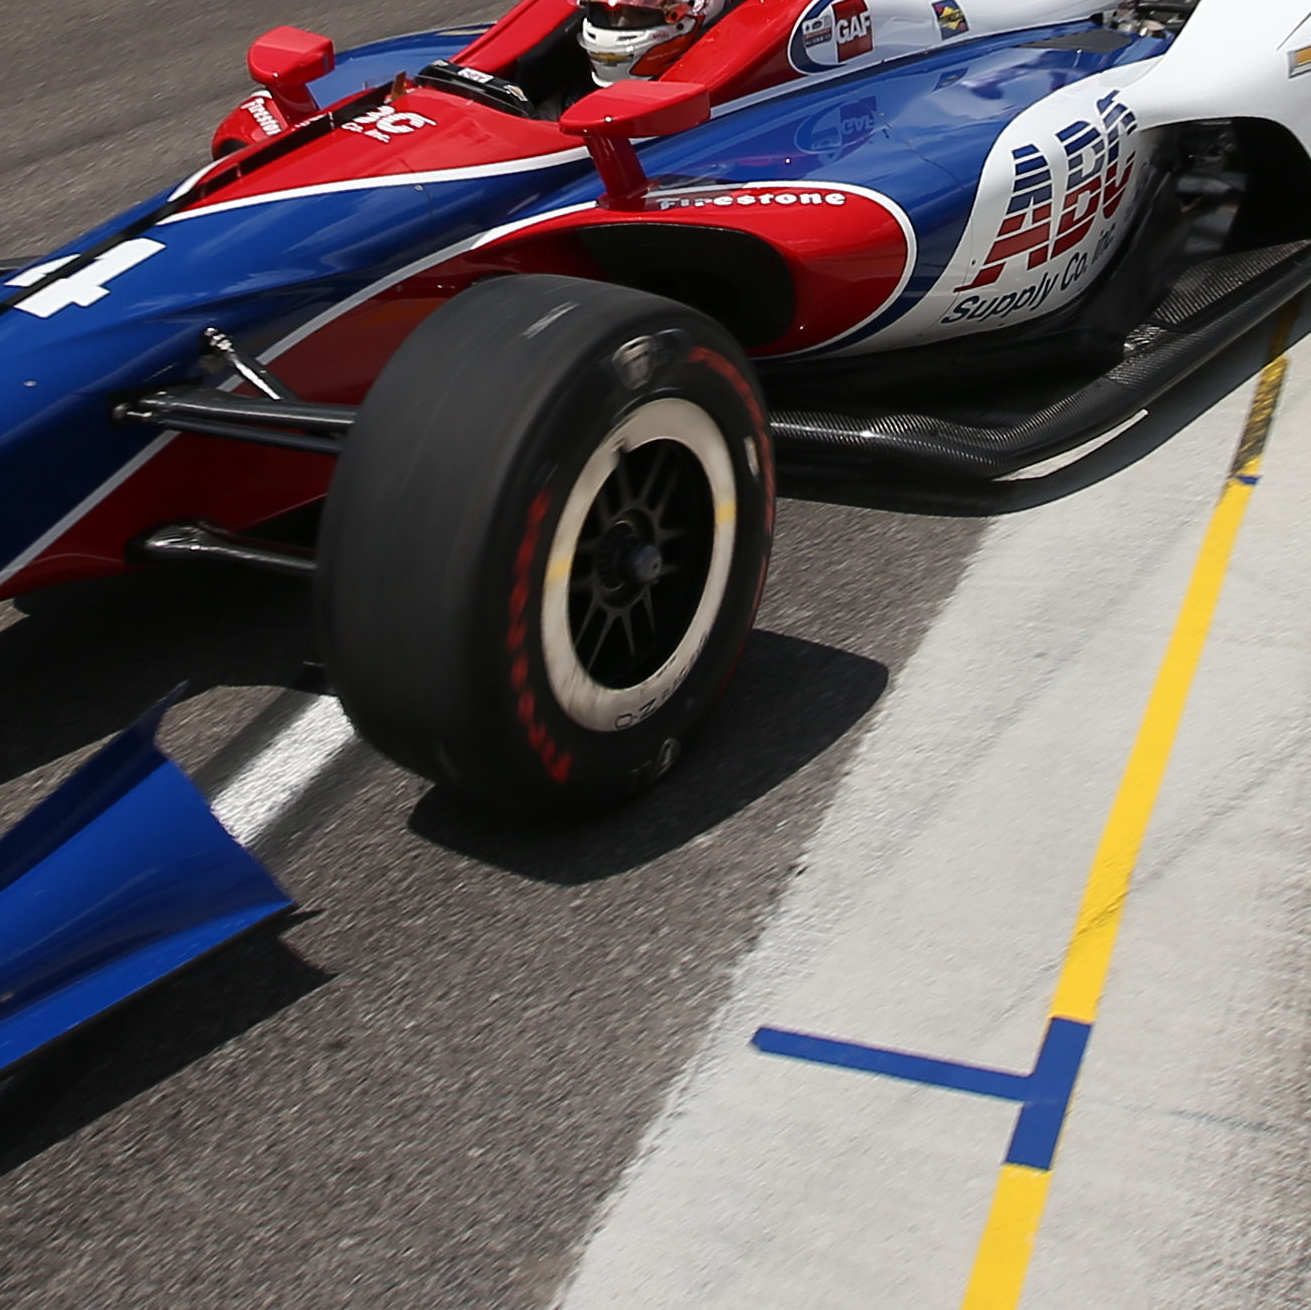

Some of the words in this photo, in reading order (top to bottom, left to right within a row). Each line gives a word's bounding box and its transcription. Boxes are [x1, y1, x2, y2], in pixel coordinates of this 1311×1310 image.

[836, 11, 871, 45] GAF
[656, 192, 847, 210] Firestone
[953, 89, 1139, 293] ABC
[940, 272, 1060, 324] Supply
